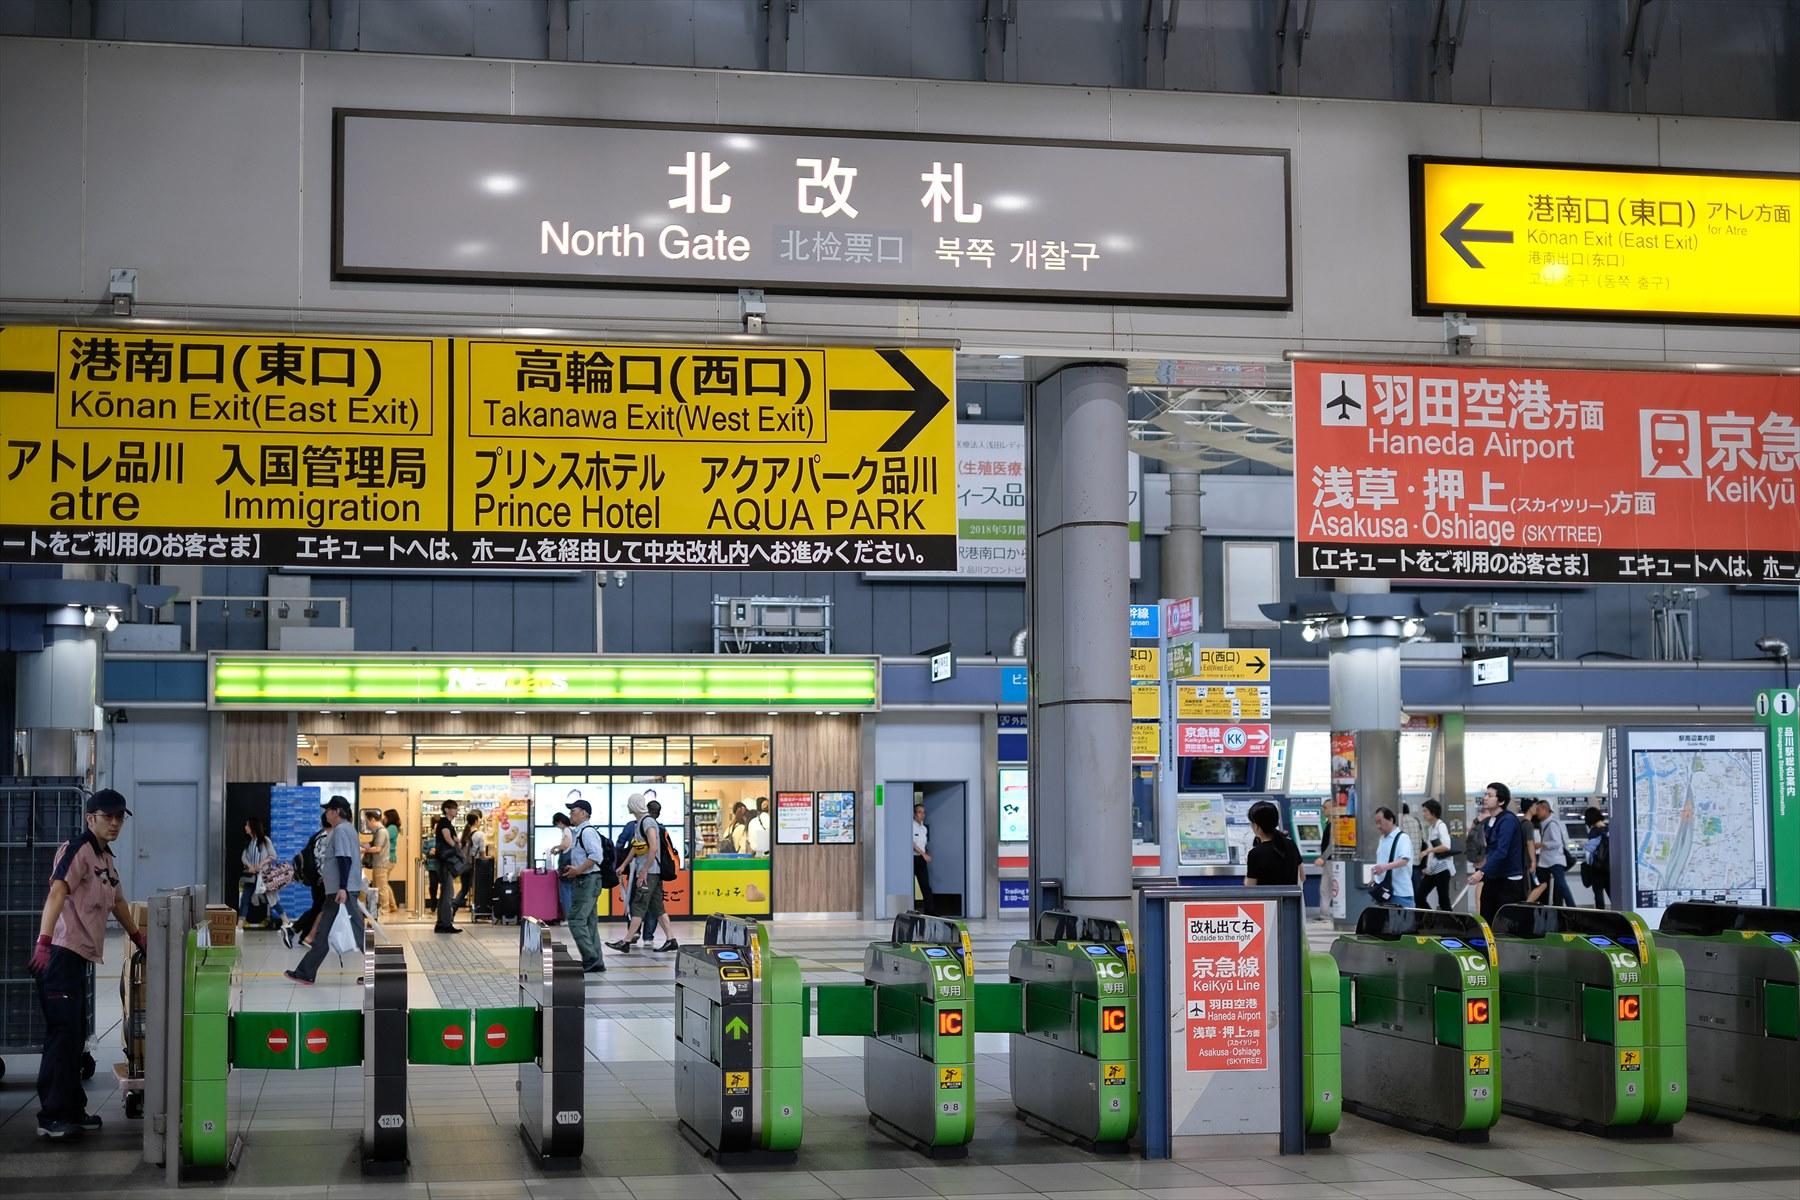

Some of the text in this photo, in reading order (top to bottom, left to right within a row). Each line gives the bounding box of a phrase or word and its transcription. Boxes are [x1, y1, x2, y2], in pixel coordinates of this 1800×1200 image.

[1707, 202, 1791, 224] アトレ方面
[1707, 224, 1722, 235] for
[541, 221, 751, 262] North Gate
[780, 230, 904, 264] 北检票口
[1527, 229, 1699, 252] Kōnan Exit (East Exit)
[935, 236, 1101, 272] 북쪽 개찰구
[69, 337, 383, 396] 港南口（東口）
[516, 349, 812, 404] 高輪口（西口）
[71, 390, 178, 420] Kōnan
[347, 398, 420, 431] Exit)
[1371, 374, 1605, 432] 羽田空港方面
[483, 401, 617, 430] Takanawa
[758, 405, 815, 439] Exit)
[1368, 428, 1576, 464] Haneda Airport
[1706, 410, 1800, 474] 京急
[8, 440, 427, 491] アトレ品川 入国管理局
[474, 446, 939, 496] プリンスホテル アクアパーク品川
[1706, 476, 1796, 511] KeiKyū
[50, 489, 420, 529] atre Immigration
[474, 494, 926, 533] Prince Hotel AQUA PARK
[1522, 525, 1603, 546] (SKYTREE)
[1227, 734, 1242, 745] KK
[1191, 920, 1254, 934] 改札出て右
[1192, 934, 1216, 942] Outside
[1236, 934, 1250, 943] right
[1097, 962, 1125, 979] IC
[1192, 956, 1260, 978] 京急線
[1460, 955, 1487, 971] IC
[1611, 953, 1638, 969] IC
[935, 964, 962, 981] IC
[1237, 981, 1260, 991] Line
[1209, 999, 1258, 1009] 羽田空港
[1468, 1002, 1488, 1023] IC
[1619, 999, 1639, 1019] IC
[940, 1013, 962, 1035] IC
[1104, 1010, 1125, 1031] IC
[1208, 1010, 1261, 1022] Haneda Airport
[1324, 1092, 1330, 1100] 7
[1628, 1085, 1634, 1093] 6
[1671, 1083, 1677, 1091] 5
[734, 1109, 743, 1118] 10
[783, 1107, 790, 1116] 9
[943, 1103, 959, 1111] 9 8
[1113, 1099, 1119, 1107] 8
[204, 1122, 213, 1131] 12
